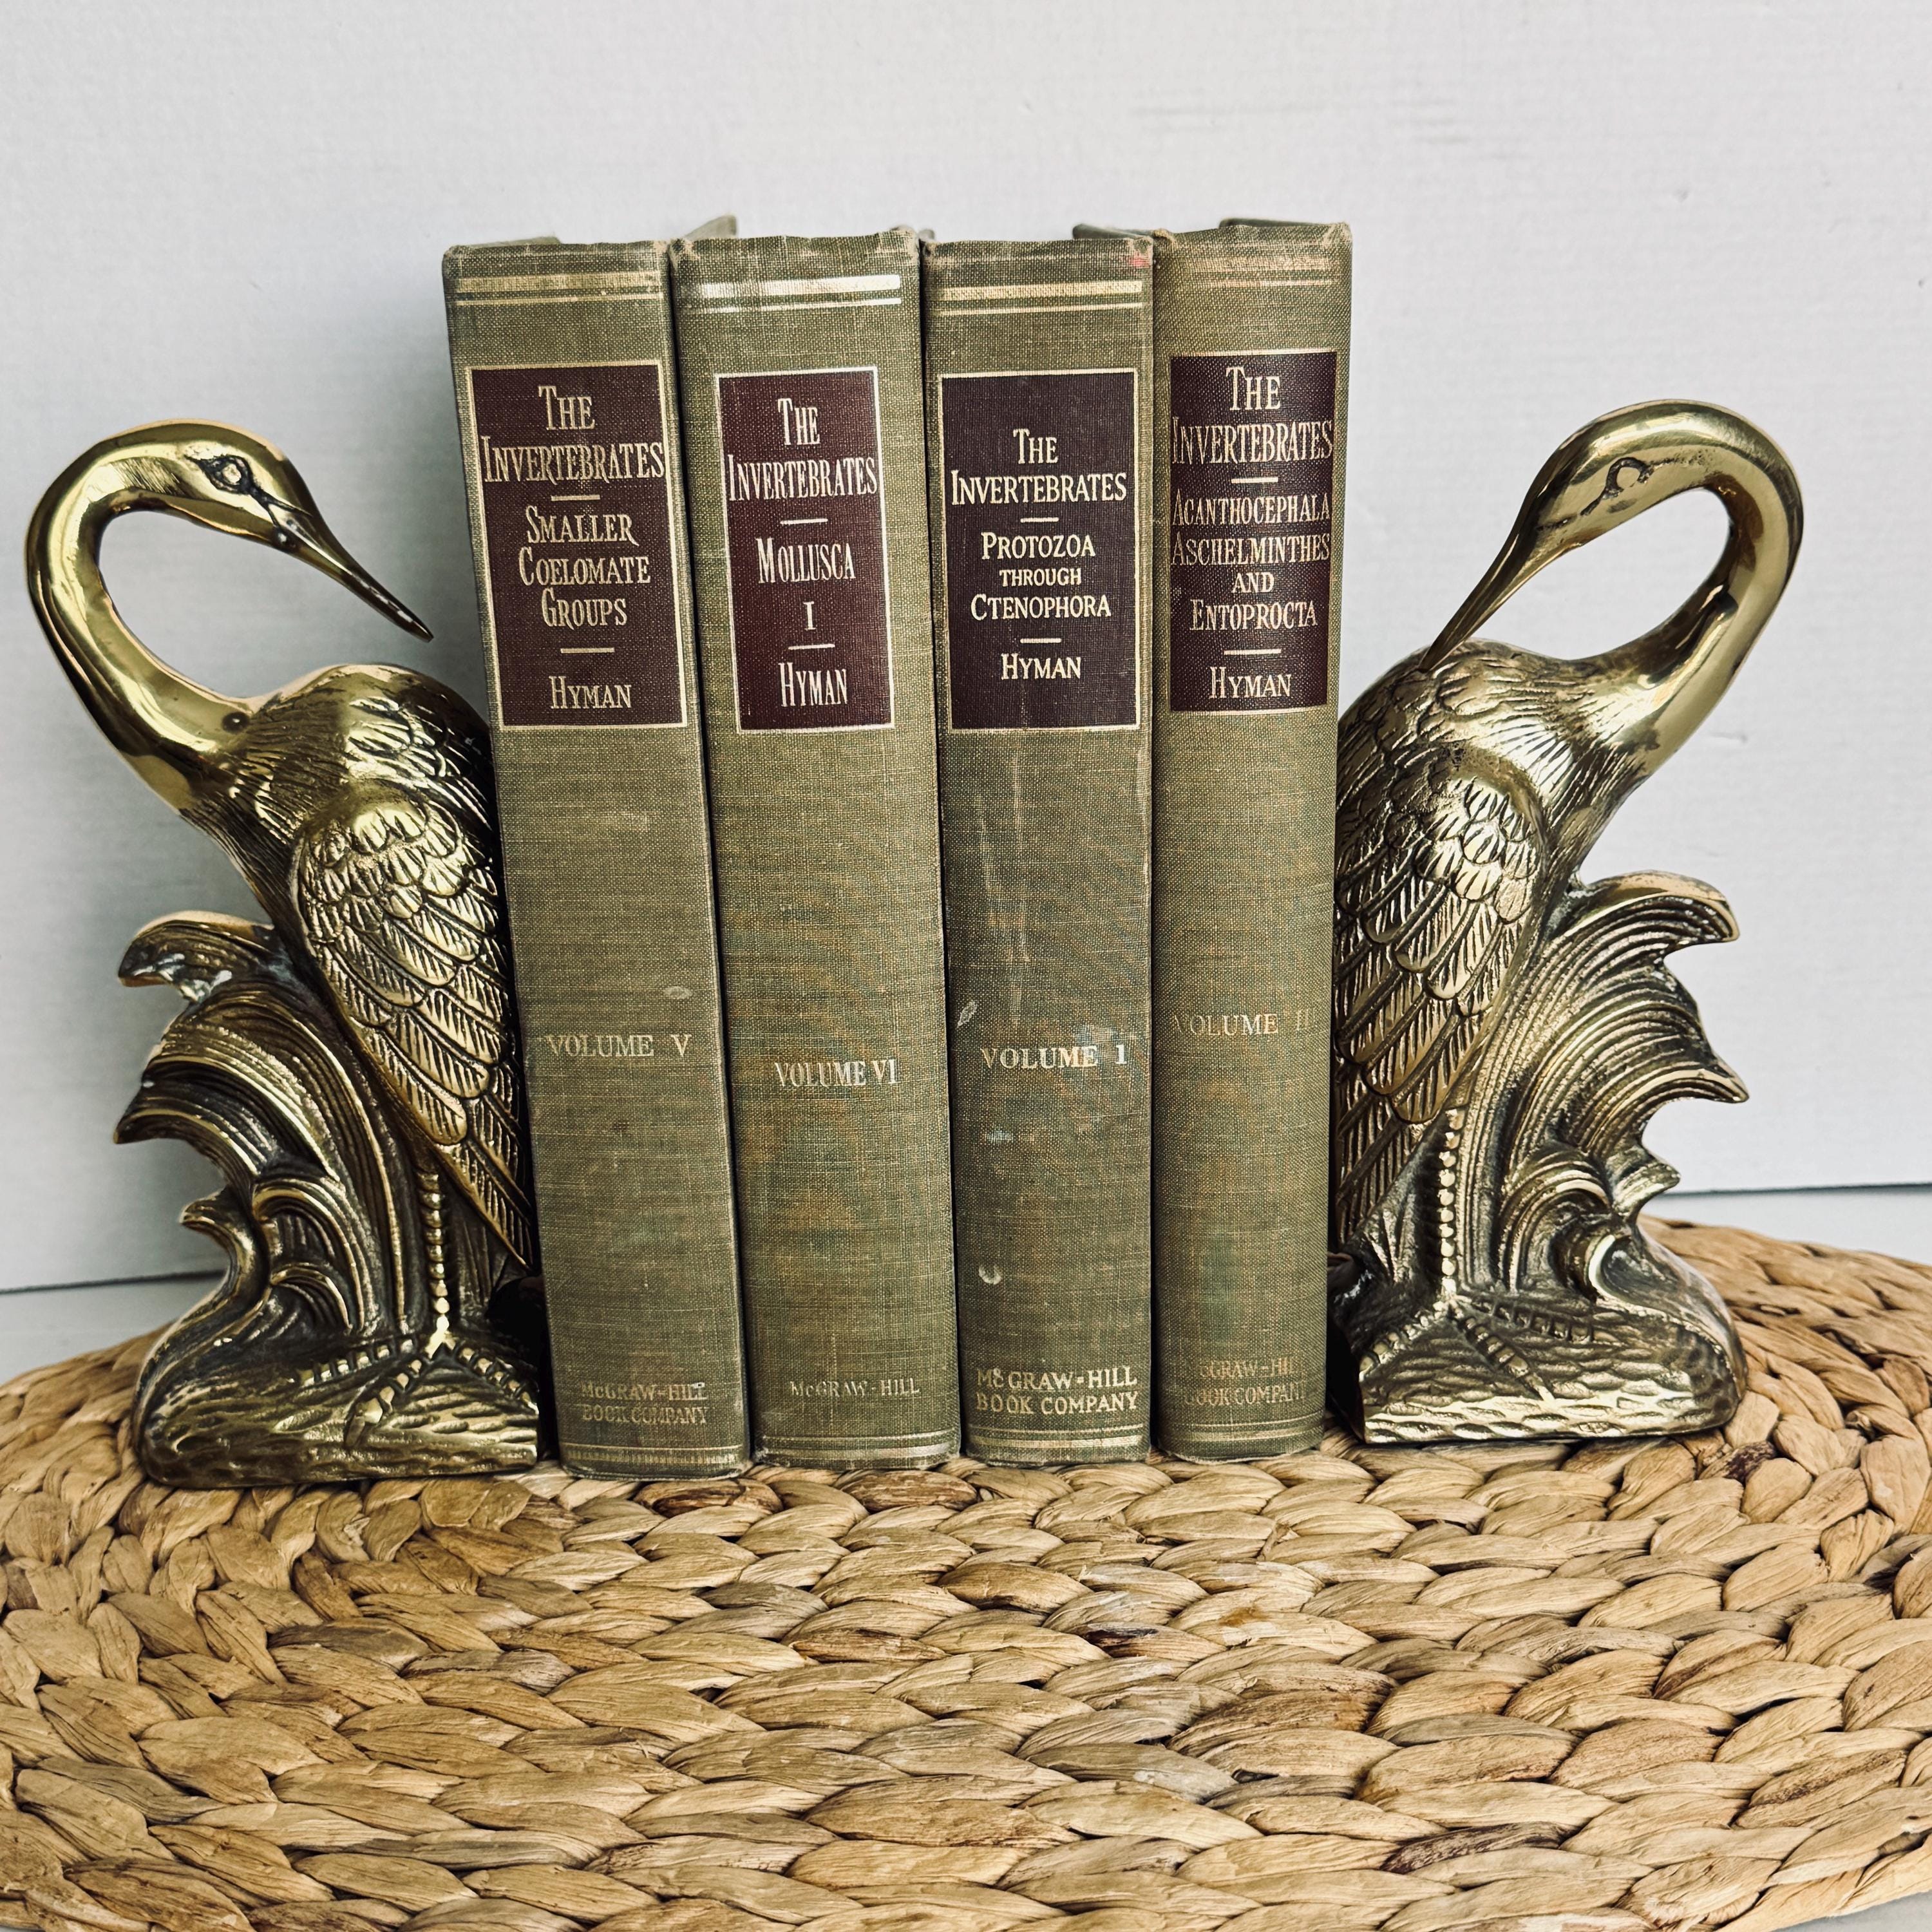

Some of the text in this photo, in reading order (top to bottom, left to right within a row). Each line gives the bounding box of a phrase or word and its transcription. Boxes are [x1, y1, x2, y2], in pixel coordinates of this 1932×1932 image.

[999, 567, 1082, 587] THROUGH
[1231, 572, 1274, 594] AND
[802, 601, 814, 630] I
[1001, 653, 1082, 681] HYMAN
[548, 676, 632, 709] HYMAN
[778, 661, 848, 707] HYMAN
[1208, 666, 1292, 699] HYMAN
[544, 1034, 692, 1057] VOLUME V
[980, 1045, 1097, 1070] VOLUME
[774, 1059, 898, 1088] VOLUME VI
[977, 1391, 1139, 1415] BOOK COMPANY
